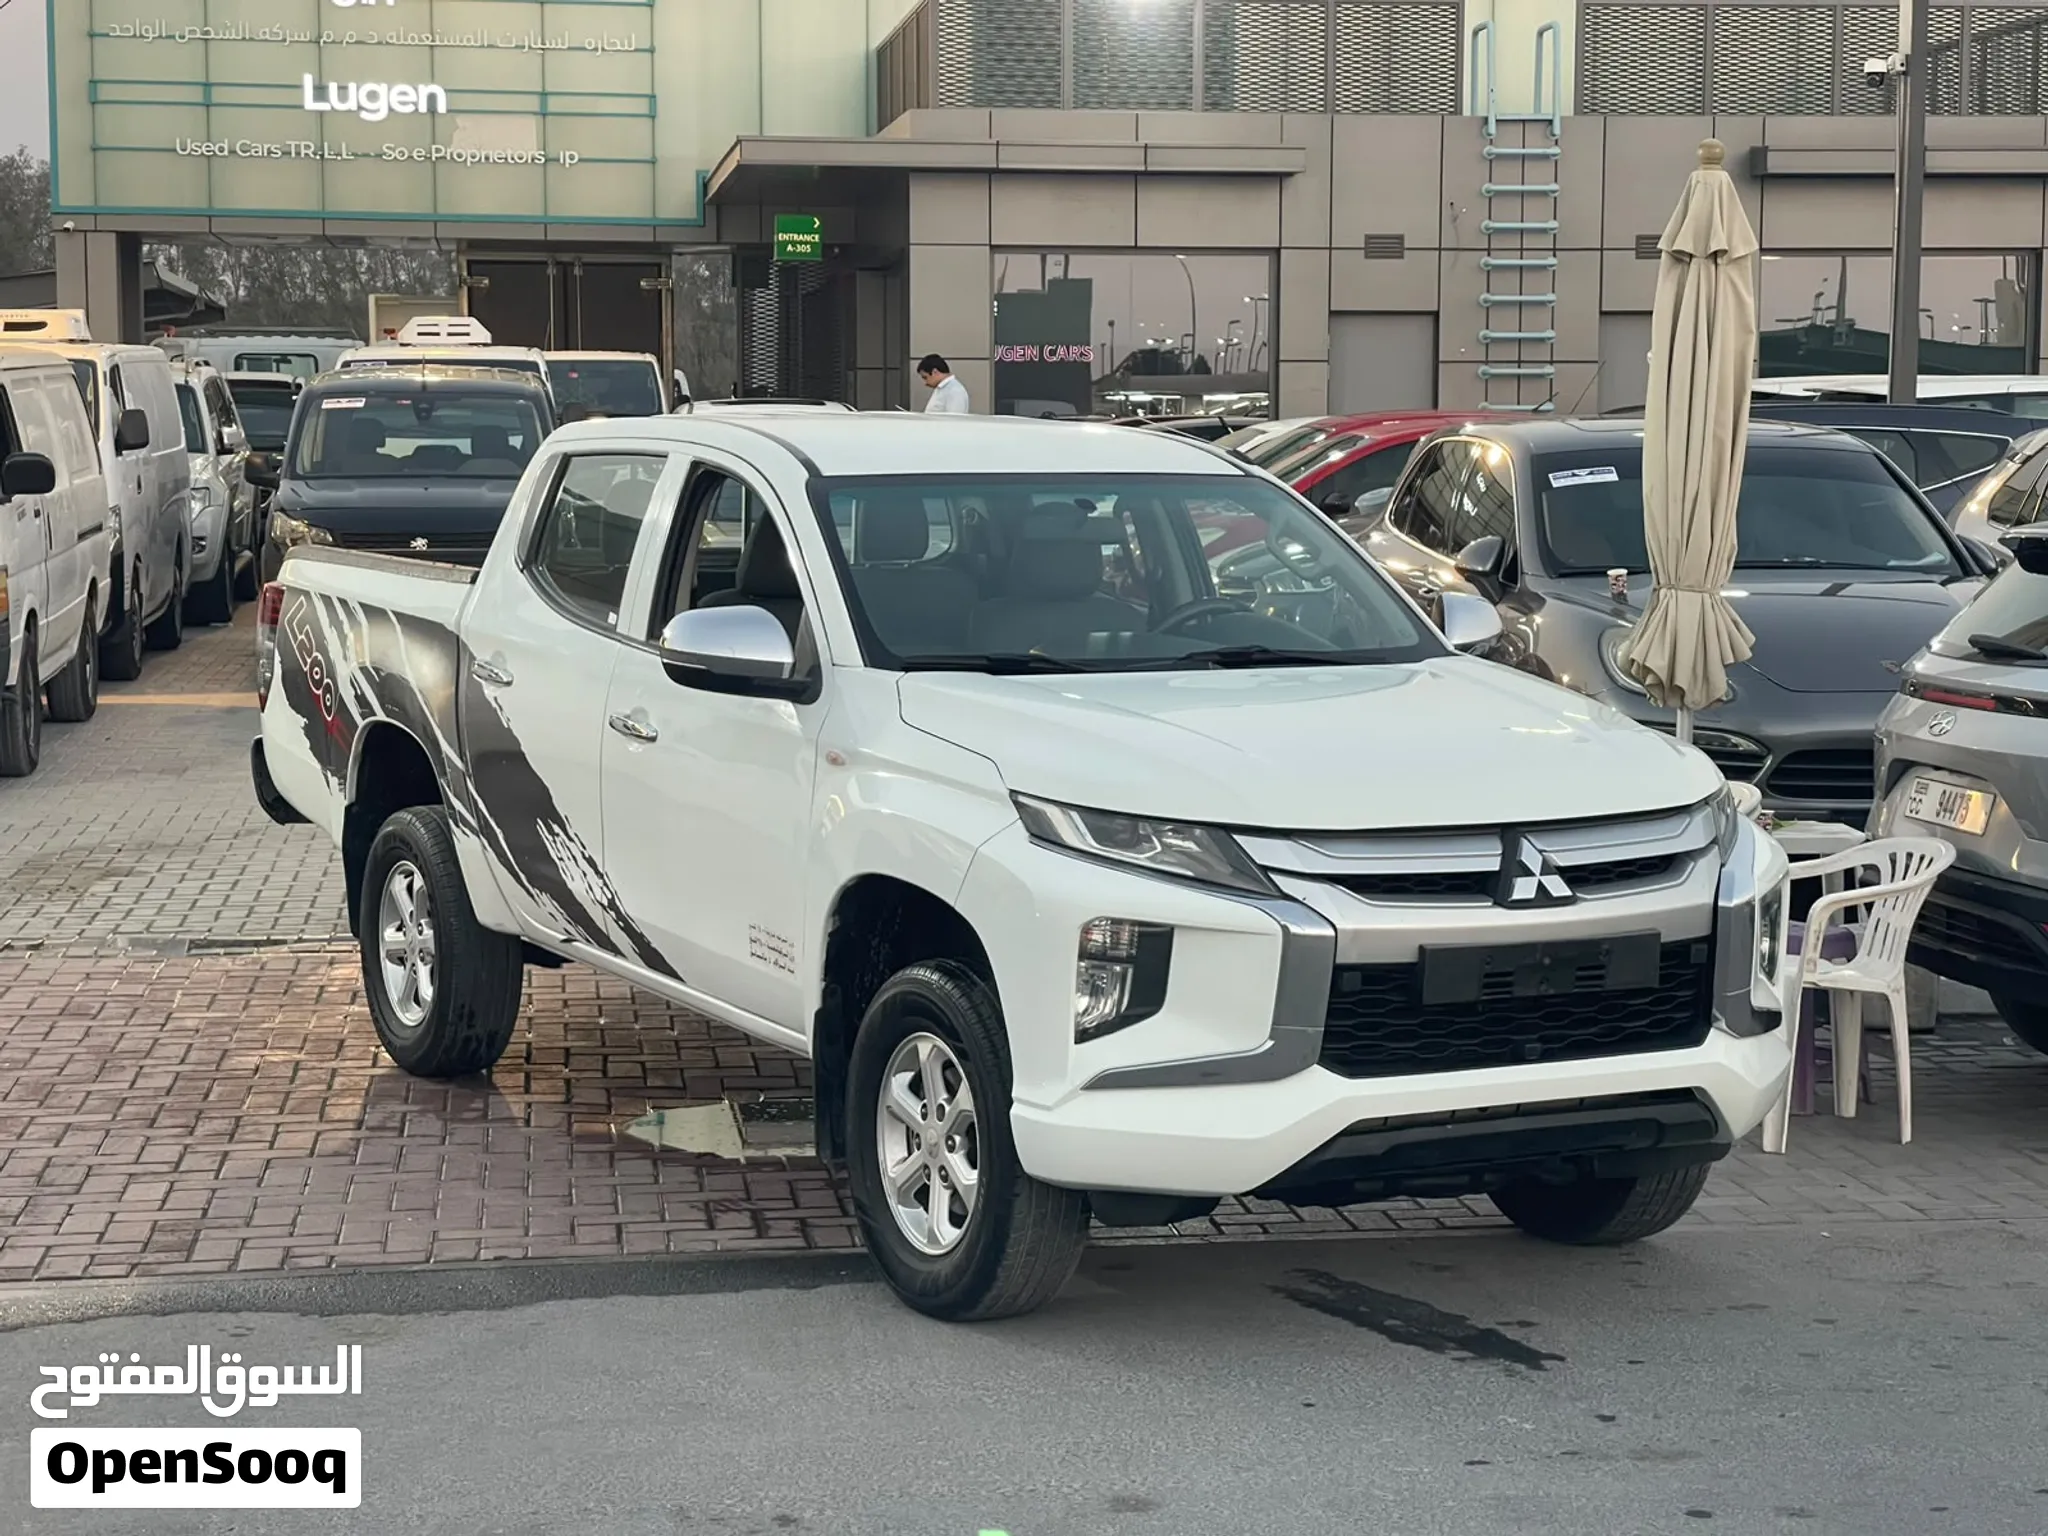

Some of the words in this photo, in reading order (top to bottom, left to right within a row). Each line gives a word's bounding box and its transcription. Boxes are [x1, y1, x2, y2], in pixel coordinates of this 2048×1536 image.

[303, 73, 447, 121] Lugen
[175, 137, 229, 156] Used
[236, 139, 282, 158] Cars
[778, 232, 820, 242] ENTRANCE
[1043, 344, 1094, 362] CARS
